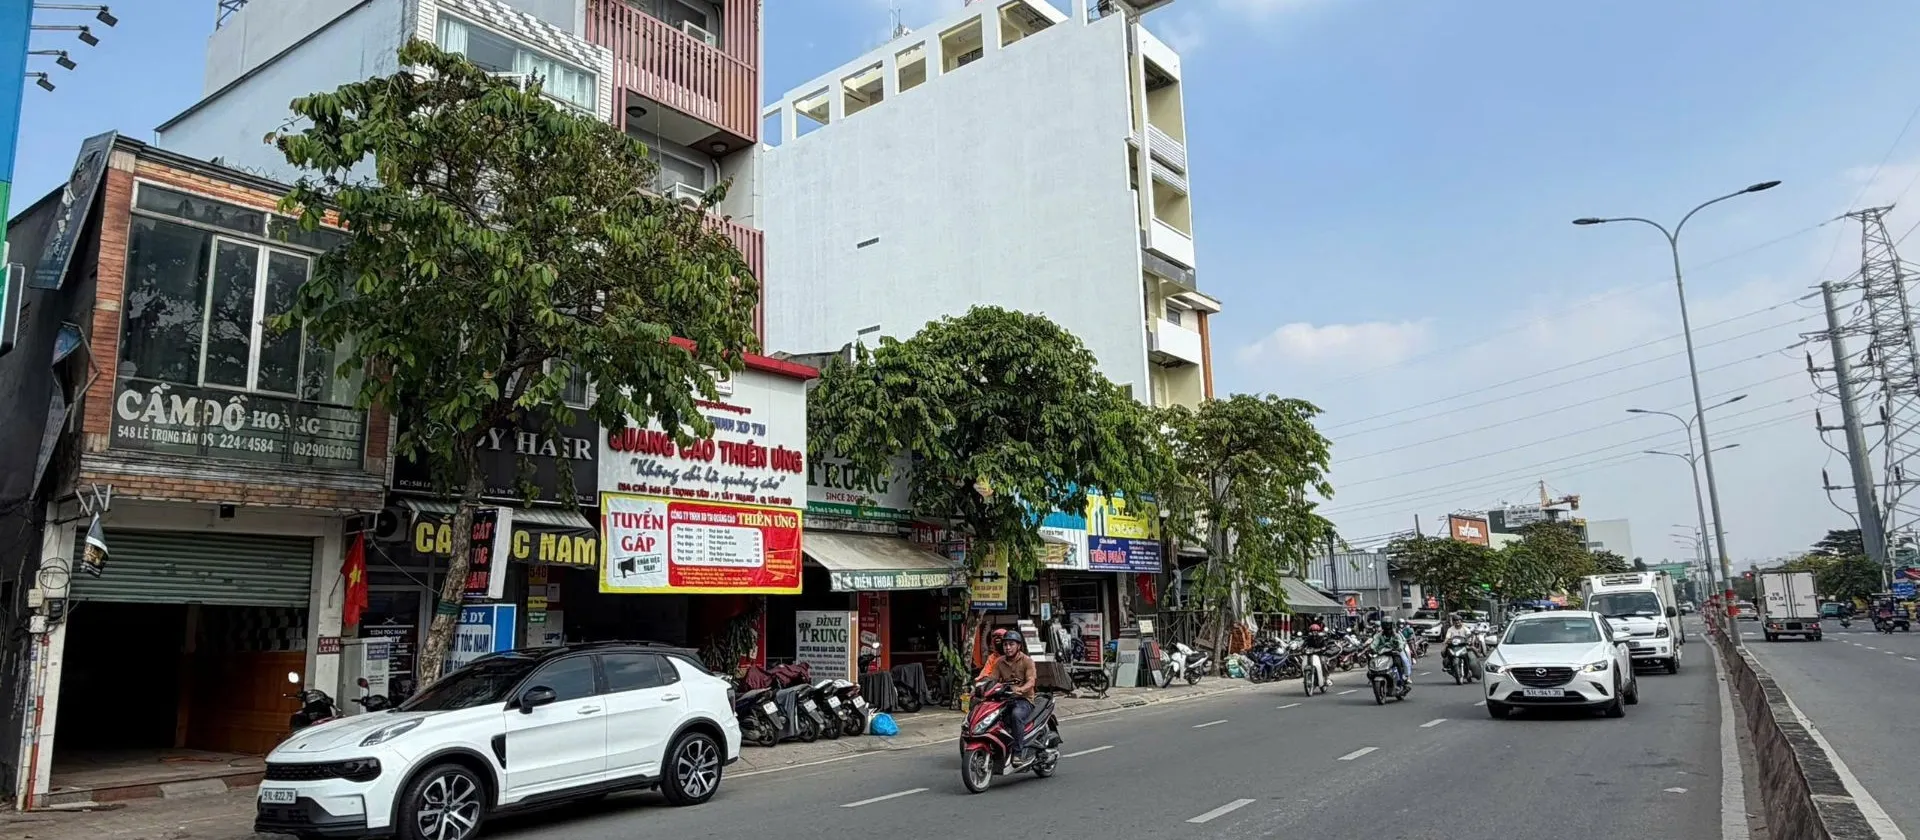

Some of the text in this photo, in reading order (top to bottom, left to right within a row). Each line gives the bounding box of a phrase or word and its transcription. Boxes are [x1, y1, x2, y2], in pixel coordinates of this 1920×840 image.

[198, 394, 245, 432] ĐỒ
[118, 425, 136, 440] 548
[137, 425, 150, 440] LÊ
[151, 428, 180, 445] TRỌNG
[826, 491, 845, 501] SINCE
[611, 507, 664, 530] TUYỂN
[736, 511, 773, 527] THIÊN
[538, 532, 597, 566] NAM
[621, 531, 656, 552] GẤP
[470, 611, 486, 623] DY
[816, 614, 842, 627] ĐÌNH
[461, 630, 473, 652] TÓC
[473, 633, 489, 653] NAM
[799, 626, 848, 643] TRUNG
